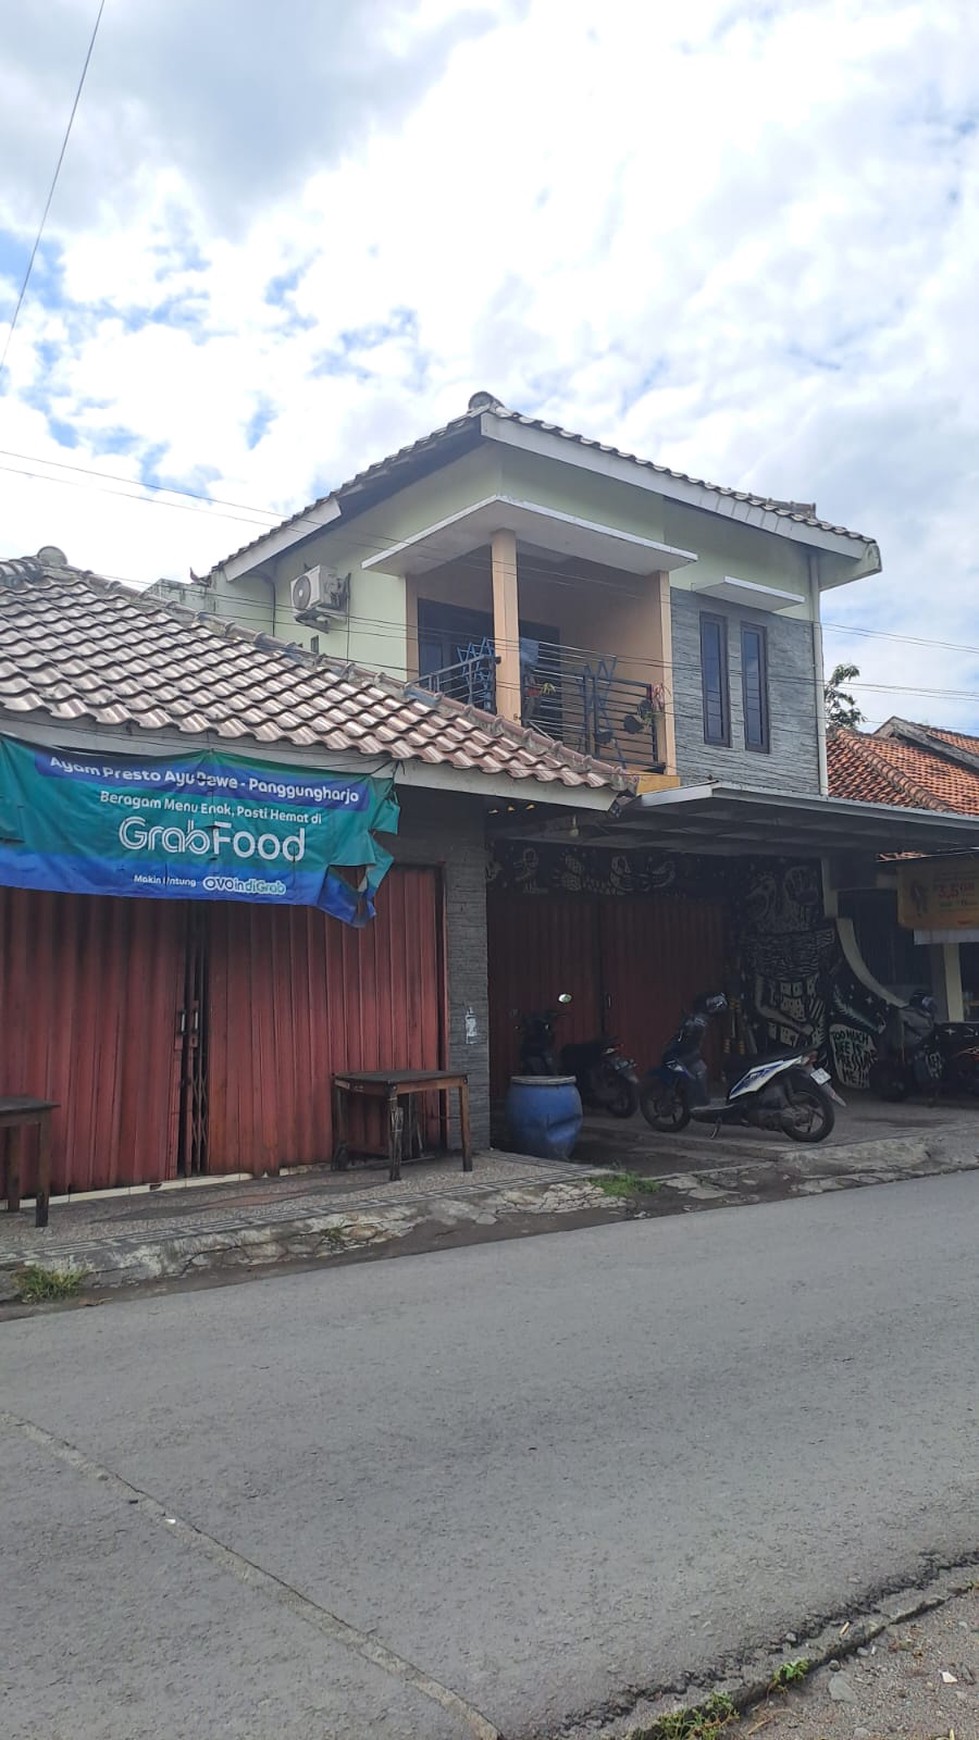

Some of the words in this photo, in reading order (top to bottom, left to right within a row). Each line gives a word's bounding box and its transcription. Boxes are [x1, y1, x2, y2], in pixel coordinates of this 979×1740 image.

[50, 757, 100, 776] Ayam
[102, 766, 161, 781] Presto
[164, 770, 195, 787] Ayu
[249, 778, 359, 804] Panggungharjo
[100, 791, 161, 809] Beragam
[164, 798, 198, 813] Menu
[201, 803, 235, 818] Enak,
[236, 806, 268, 819] Pasti
[270, 809, 308, 823] Hemat
[311, 813, 322, 824] di
[119, 816, 306, 862] GrabFood
[134, 874, 161, 885] Makin
